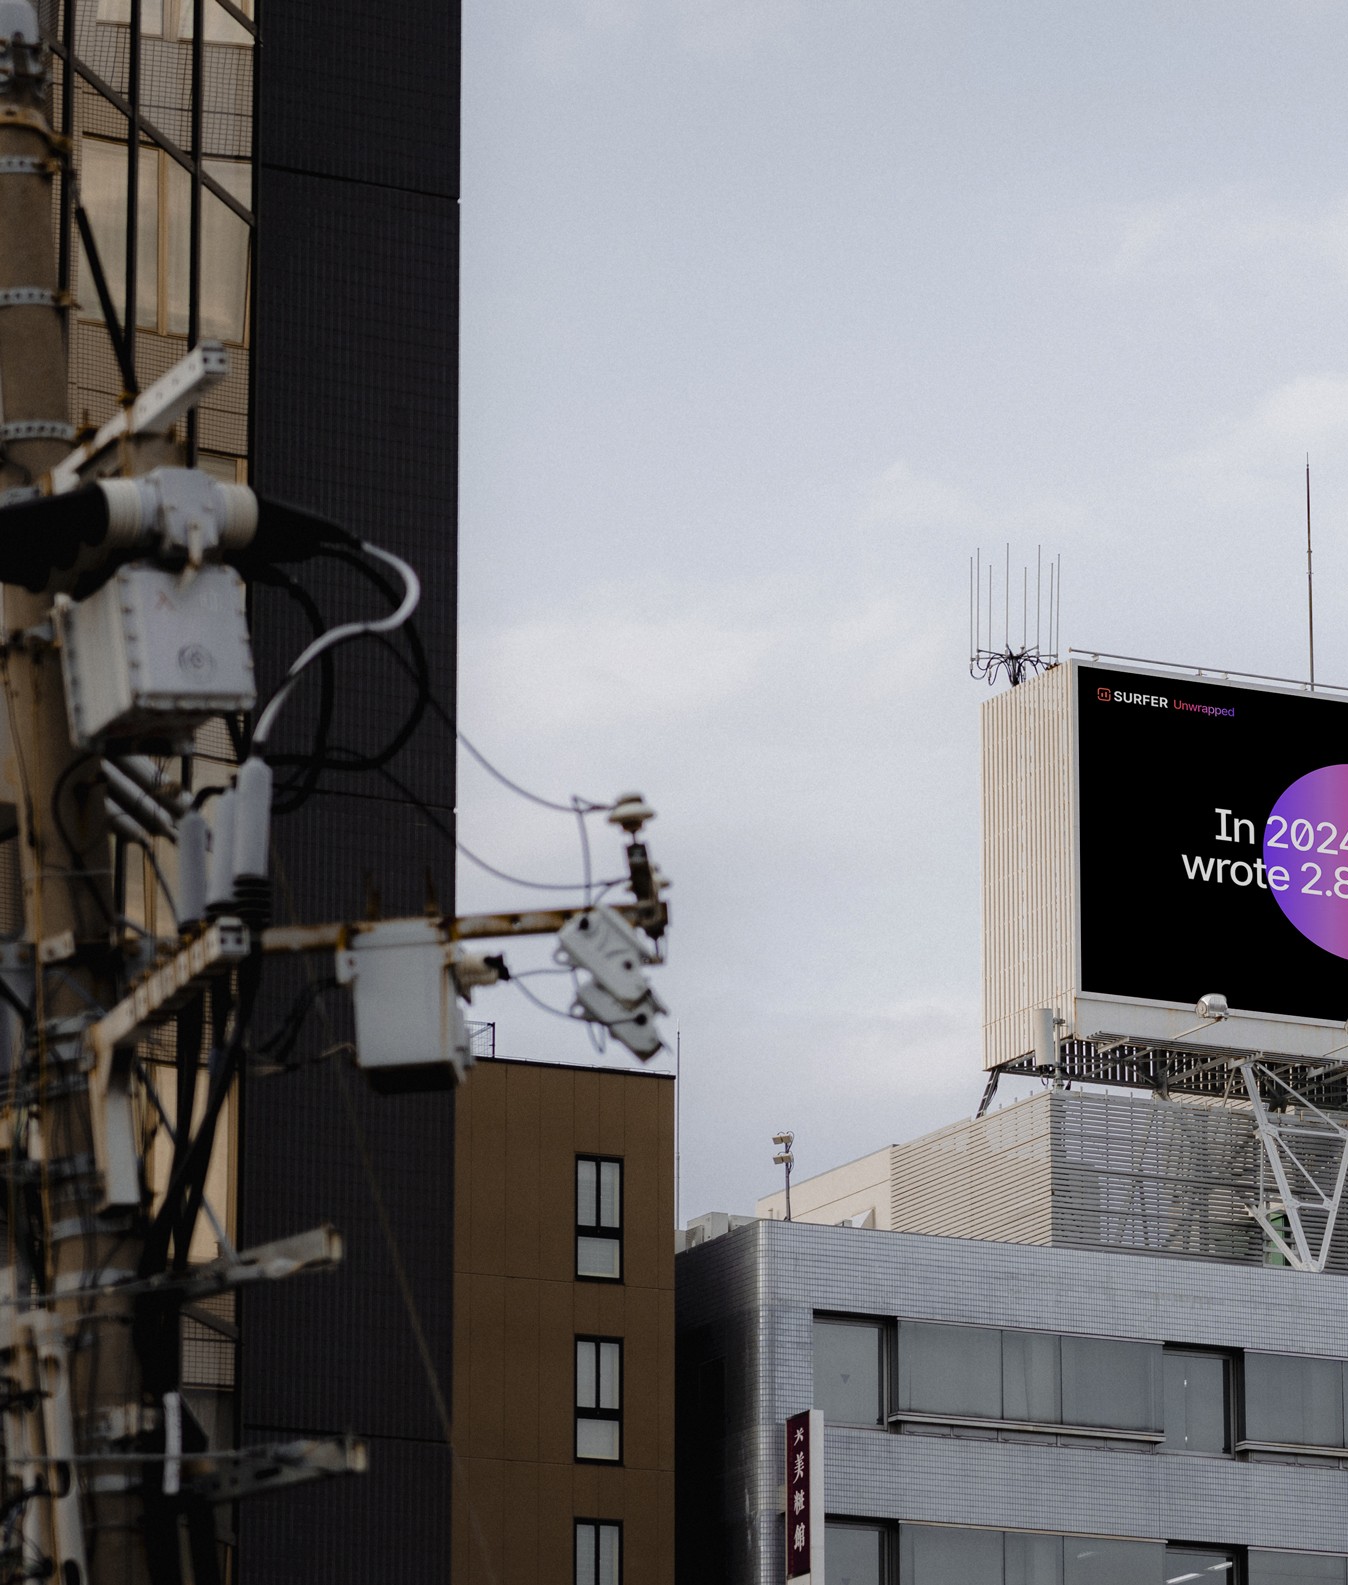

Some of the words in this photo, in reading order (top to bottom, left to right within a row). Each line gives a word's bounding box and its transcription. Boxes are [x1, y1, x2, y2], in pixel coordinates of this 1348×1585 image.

[1113, 690, 1169, 709] SURFER
[1173, 699, 1235, 717] Unwrapped
[1214, 807, 1256, 845] In
[1181, 853, 1291, 892] wrote
